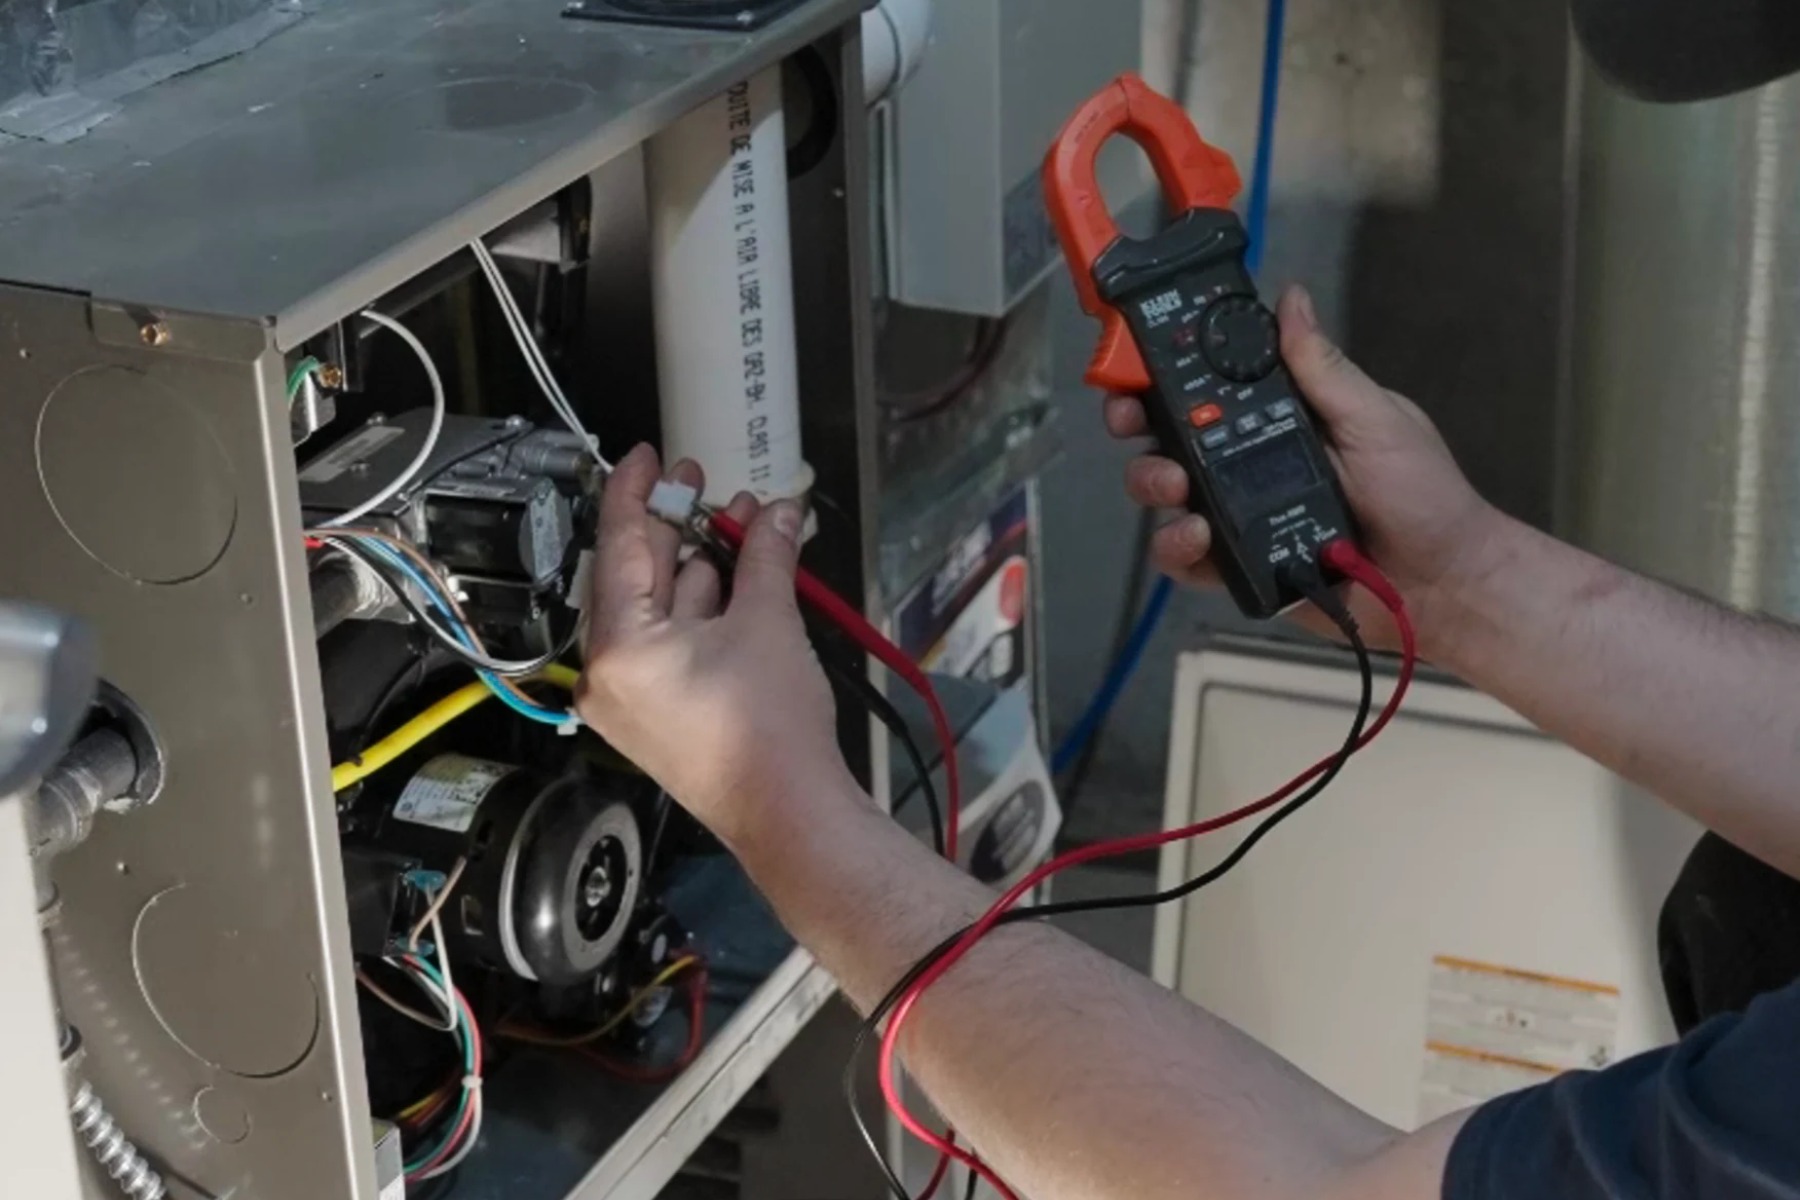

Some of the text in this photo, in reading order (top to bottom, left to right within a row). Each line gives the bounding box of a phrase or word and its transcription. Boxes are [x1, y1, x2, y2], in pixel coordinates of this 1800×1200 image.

[729, 134, 752, 156] DE
[731, 159, 755, 198] MISE
[734, 203, 755, 216] A
[734, 219, 759, 266] L'AIR
[738, 267, 762, 315] LIBRE
[741, 318, 763, 347] DES
[747, 415, 769, 460] CLASS
